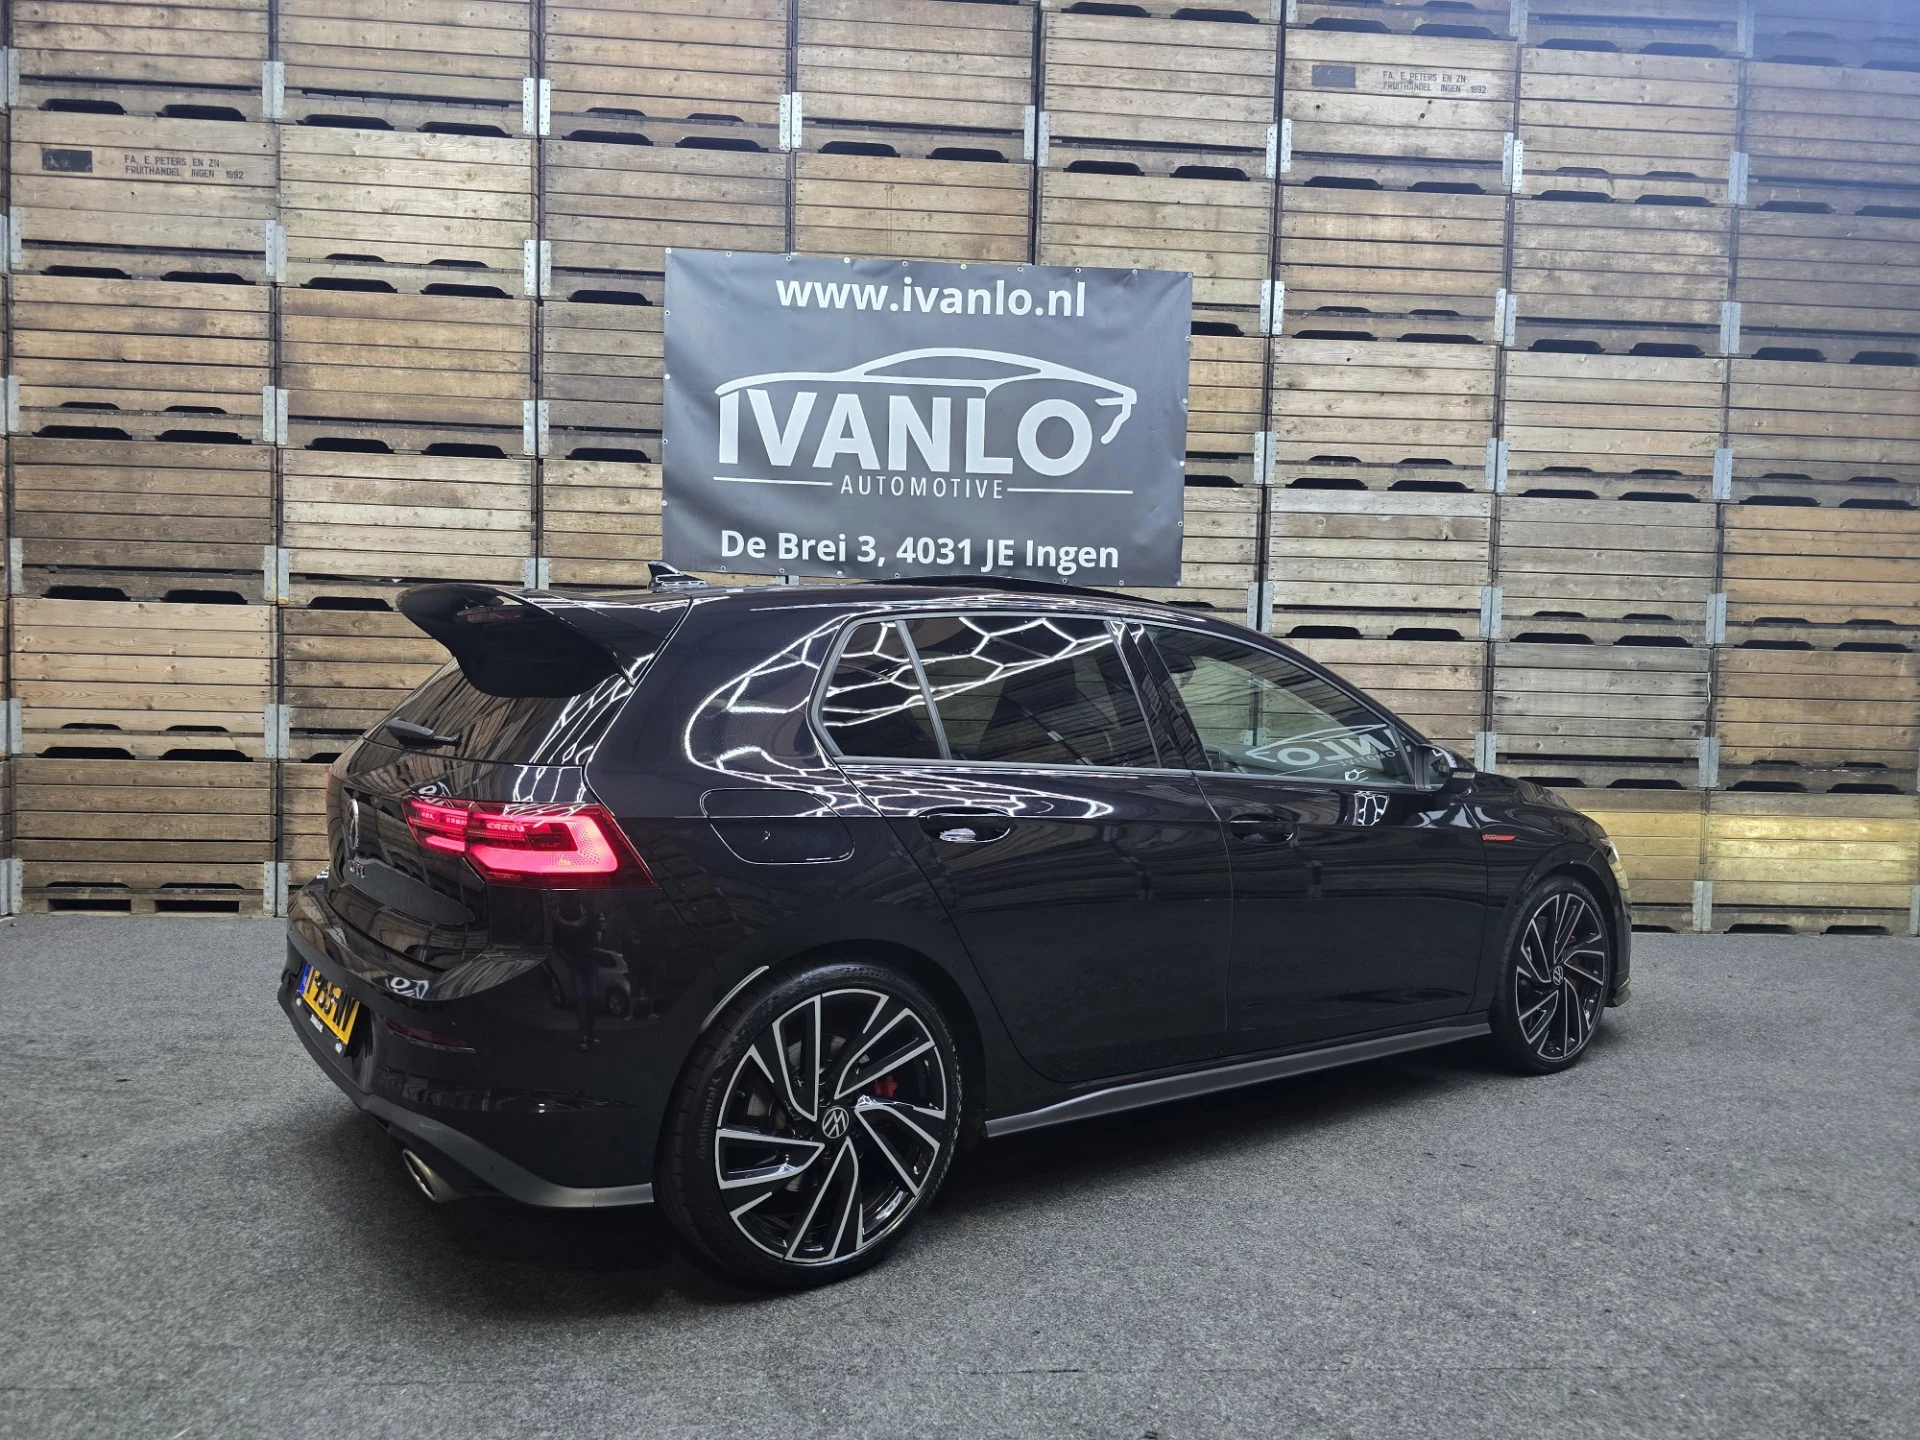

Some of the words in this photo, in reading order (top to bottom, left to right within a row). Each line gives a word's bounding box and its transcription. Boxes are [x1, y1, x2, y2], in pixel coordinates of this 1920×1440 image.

[1383, 81, 1432, 92] FRUITHANDEL
[1440, 84, 1461, 93] INGEN
[1409, 73, 1438, 82] PETERS
[1442, 74, 1453, 83] EN
[1456, 75, 1467, 84] ZN
[125, 165, 181, 177] FRUITHANDEL
[191, 168, 215, 178] INGEN
[155, 156, 187, 166] PETERS
[192, 158, 204, 167] EN
[208, 159, 220, 168] ZN
[775, 276, 1086, 318] www.ivanlo.nl
[717, 388, 1094, 478] IVANLO
[840, 474, 1004, 499] AUTOMOTIVE
[720, 529, 766, 559] De
[777, 531, 847, 562] Brei
[856, 534, 887, 568] 3,
[896, 535, 972, 566] 4031
[979, 537, 1015, 574] JE
[1025, 538, 1120, 577] Ingen
